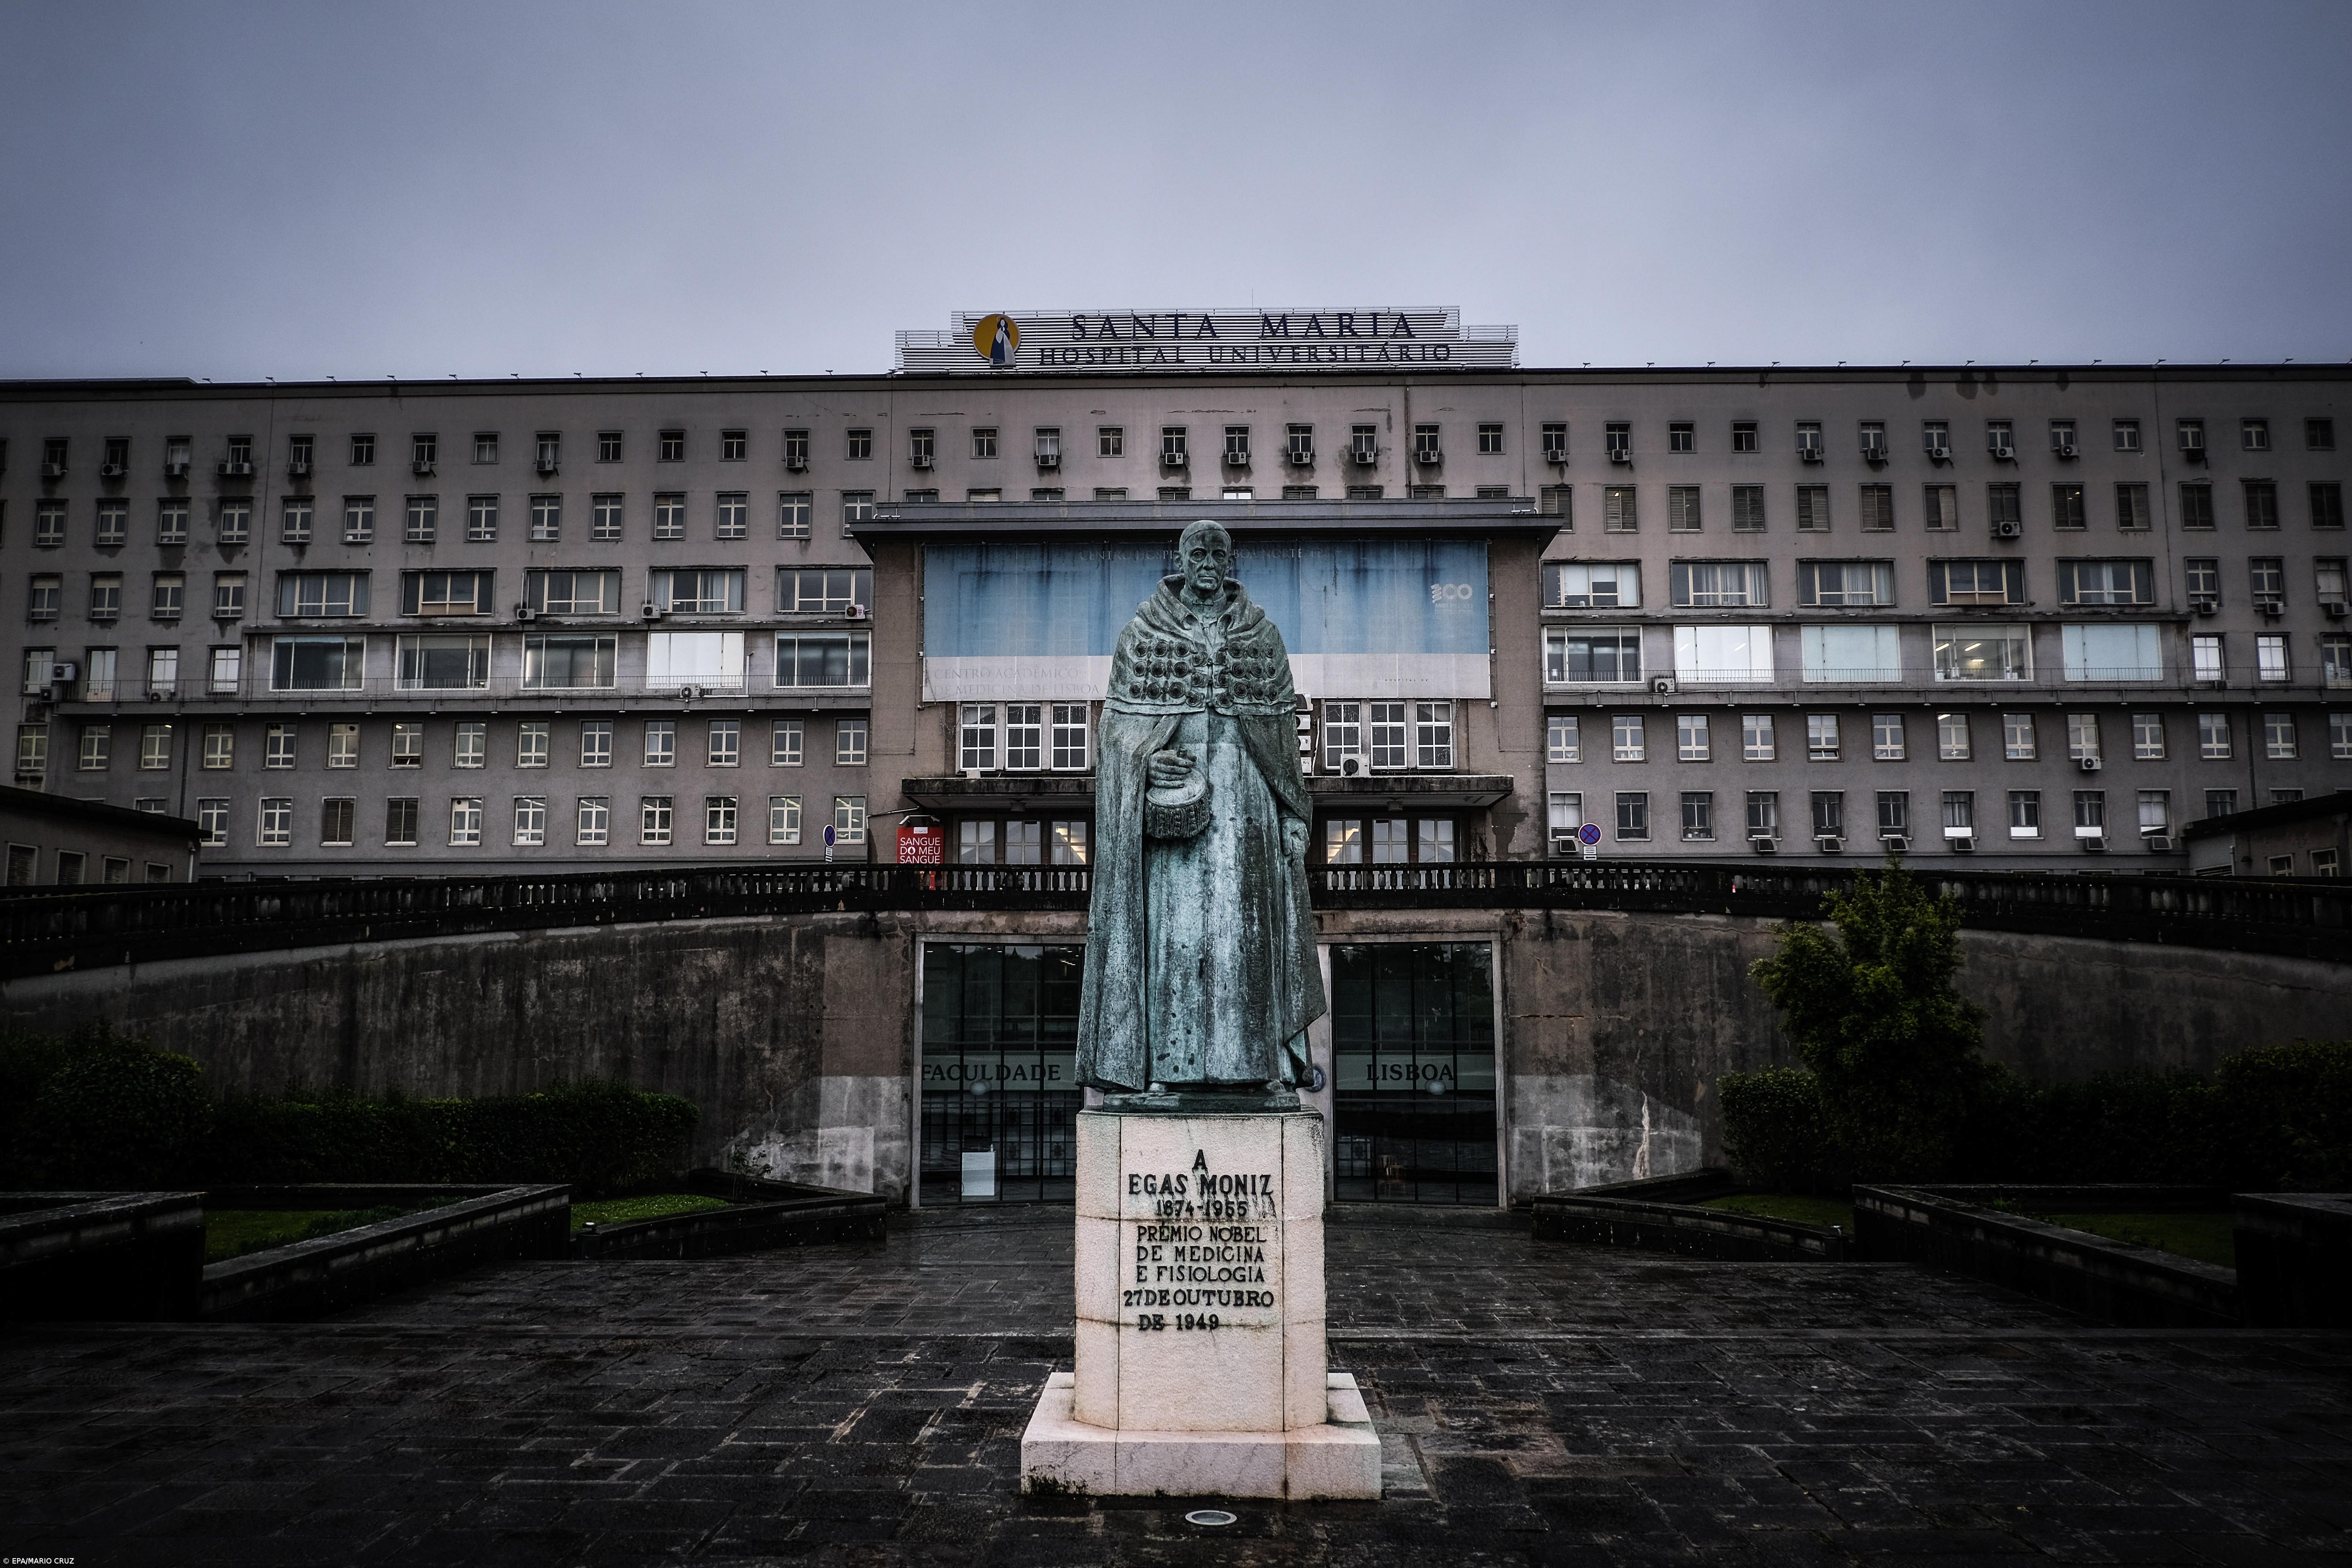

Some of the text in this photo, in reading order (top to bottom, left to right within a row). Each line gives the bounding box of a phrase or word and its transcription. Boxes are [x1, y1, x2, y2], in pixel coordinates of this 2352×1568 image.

[1072, 312, 1416, 340] SANTA MARIA
[1040, 342, 1451, 364] HOSPITAL UNIVERSITÁRIO
[934, 668, 991, 679] CENTRO
[900, 837, 940, 846] SANGUE
[900, 855, 940, 864] SANGUE
[922, 1064, 1061, 1081] FACULDADE
[1367, 1064, 1455, 1081] LISBOA
[1193, 1149, 1208, 1169] A
[1129, 1174, 1273, 1195] EGAS MONIZ
[1136, 1245, 1265, 1262] DE MEDICINA
[1136, 1265, 1265, 1282] E FISIOLOGIA
[1173, 1288, 1274, 1307] OUTUBRO
[1138, 1313, 1219, 1331] DE 1949
